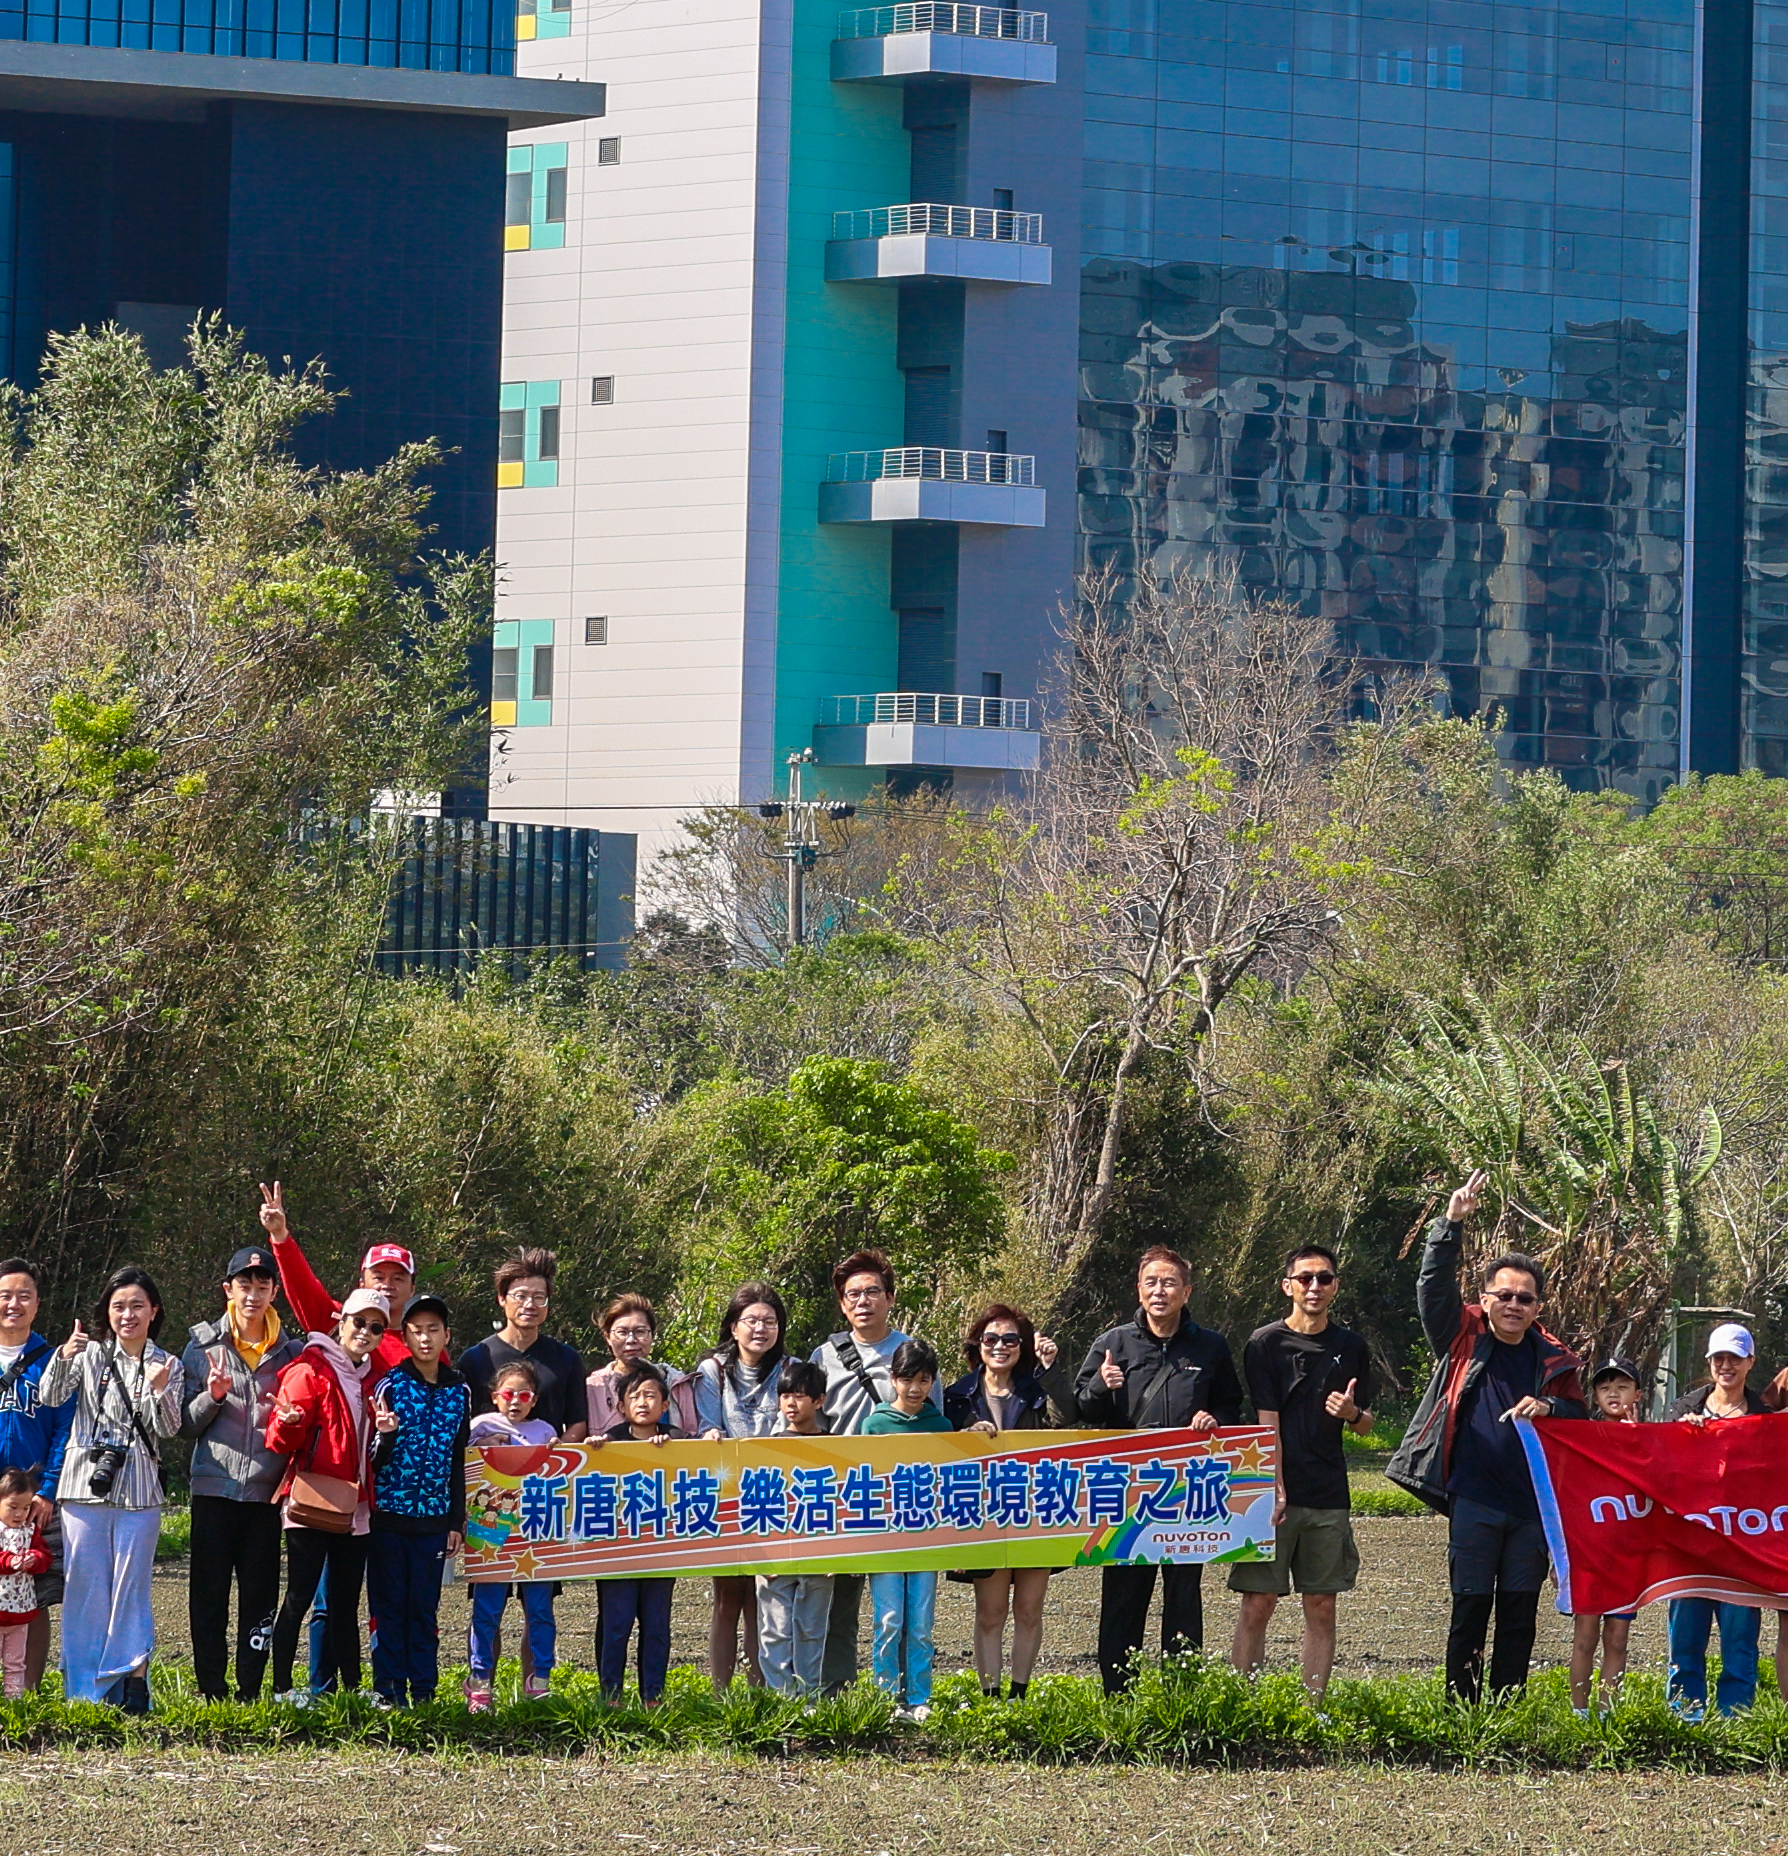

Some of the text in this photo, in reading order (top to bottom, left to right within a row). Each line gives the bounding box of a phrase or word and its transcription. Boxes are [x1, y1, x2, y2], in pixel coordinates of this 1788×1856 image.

[520, 1457, 1233, 1541] 新唐科技 樂活生態環境教育之旅
[1165, 1544, 1219, 1554] 新唐科技
